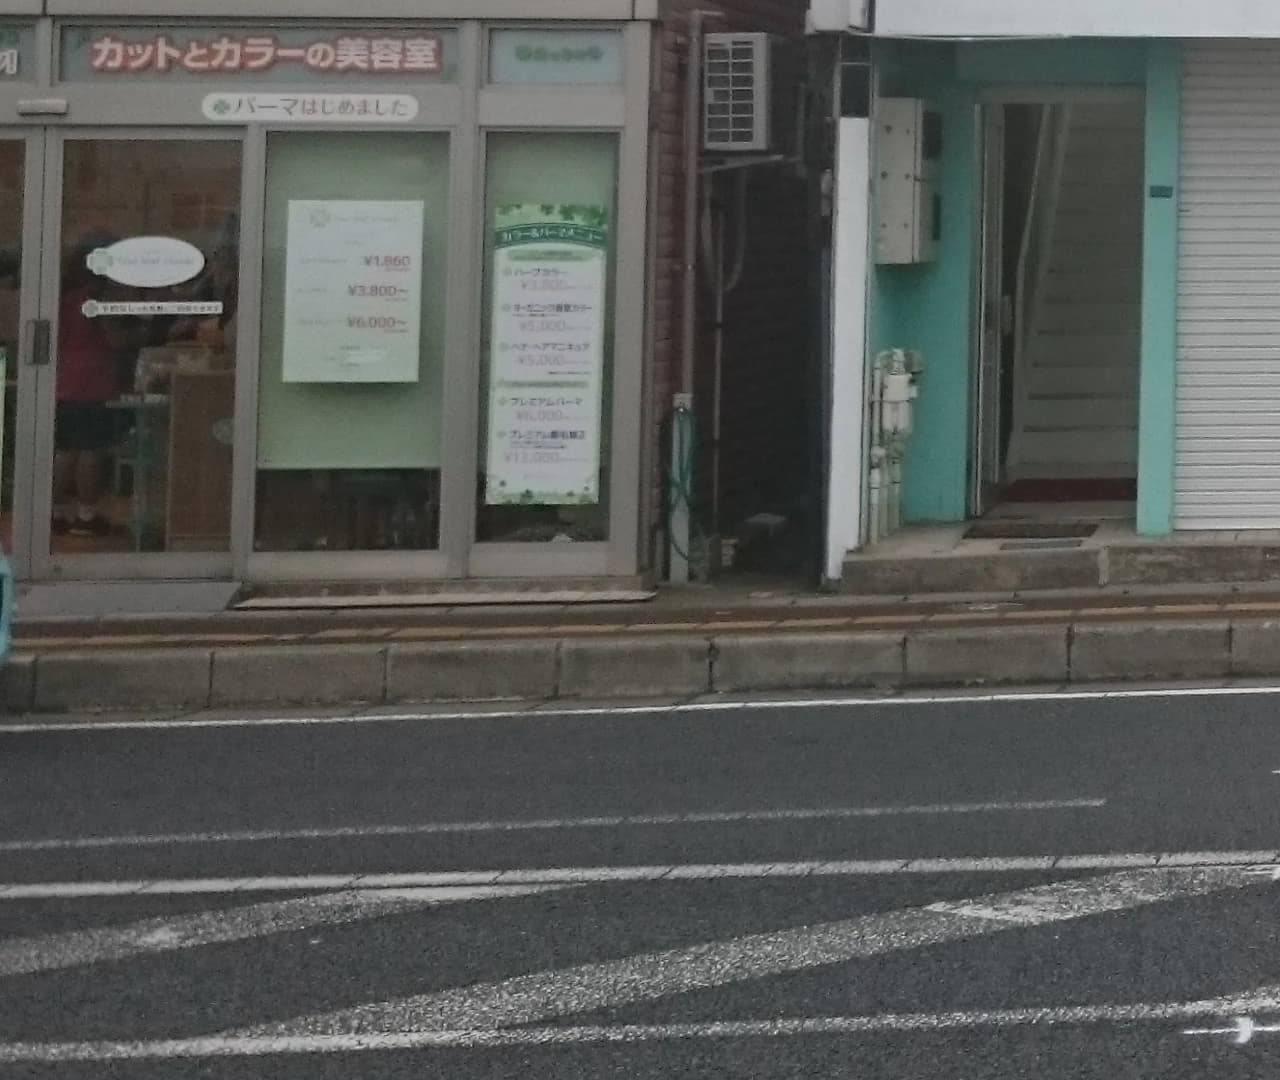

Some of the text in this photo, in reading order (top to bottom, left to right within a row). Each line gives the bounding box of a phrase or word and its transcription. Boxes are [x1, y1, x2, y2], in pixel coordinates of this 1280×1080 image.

[91, 36, 440, 71] カットとカラーの美容室
